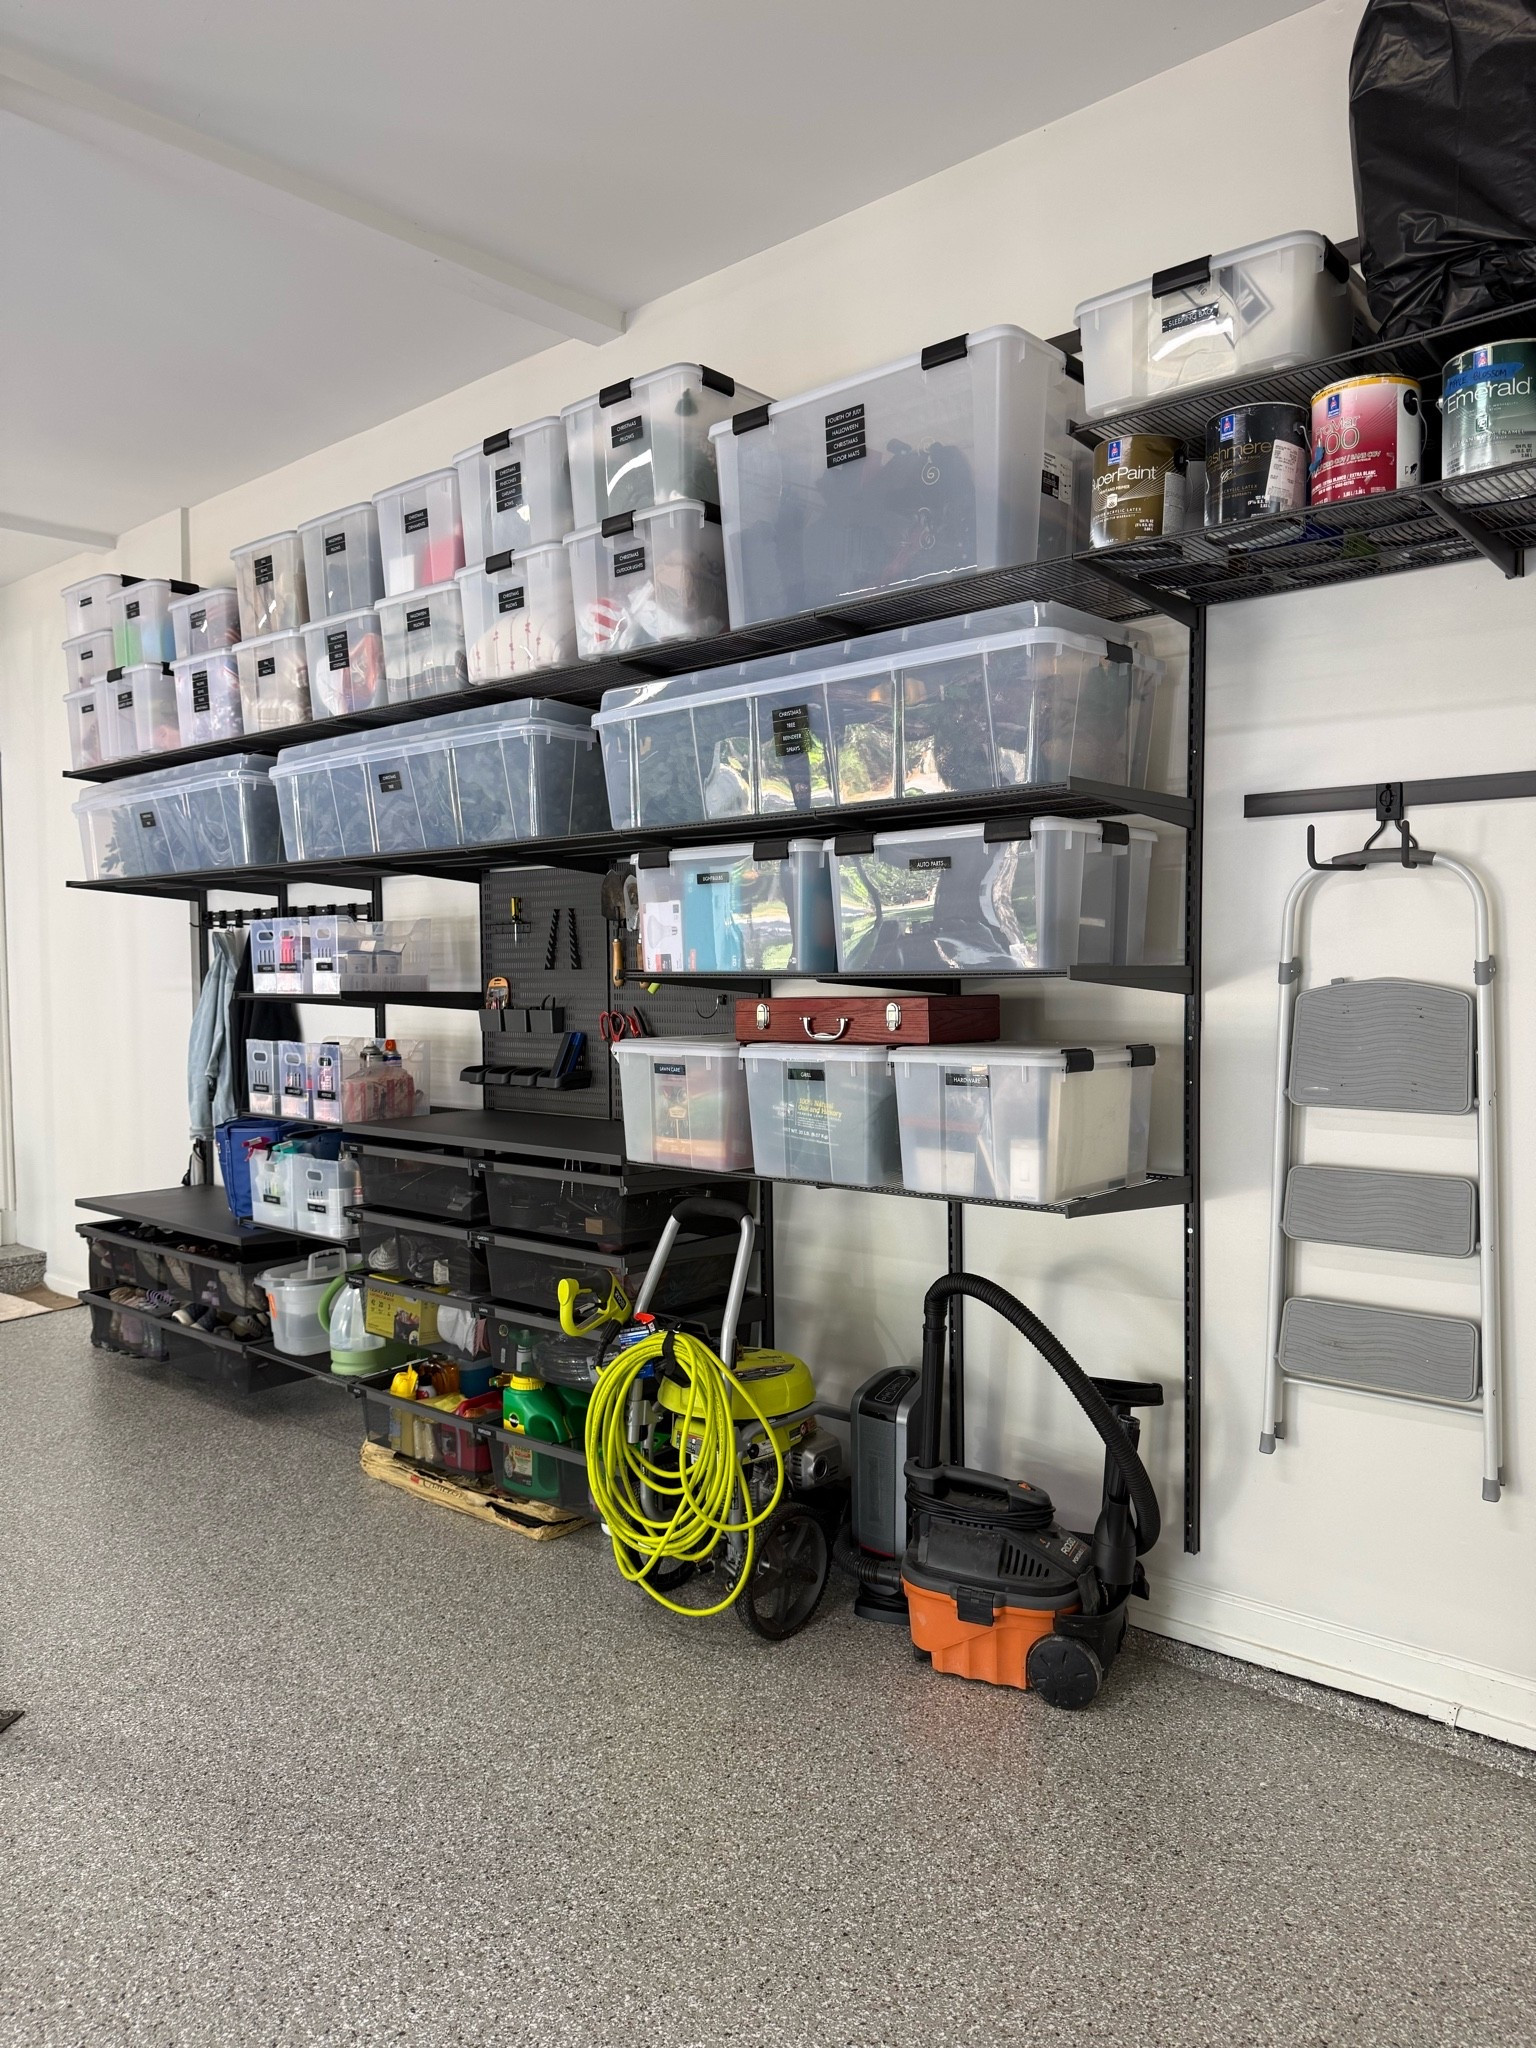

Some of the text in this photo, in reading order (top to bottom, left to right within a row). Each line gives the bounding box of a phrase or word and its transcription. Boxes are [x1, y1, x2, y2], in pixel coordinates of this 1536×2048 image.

[1473, 368, 1508, 381] BLOSSOM
[1447, 376, 1531, 415] Emerald
[827, 414, 845, 425] FOURTH
[852, 408, 862, 417] JULY
[831, 422, 859, 436] HALLOWEEN
[833, 436, 859, 450] CHRISTMAS
[832, 449, 860, 464] FLOOR MATS
[1206, 441, 1273, 467] ashmere
[778, 708, 802, 718] CHRISTMAS
[953, 1076, 981, 1084] HARDWARE
[809, 1107, 820, 1115] and
